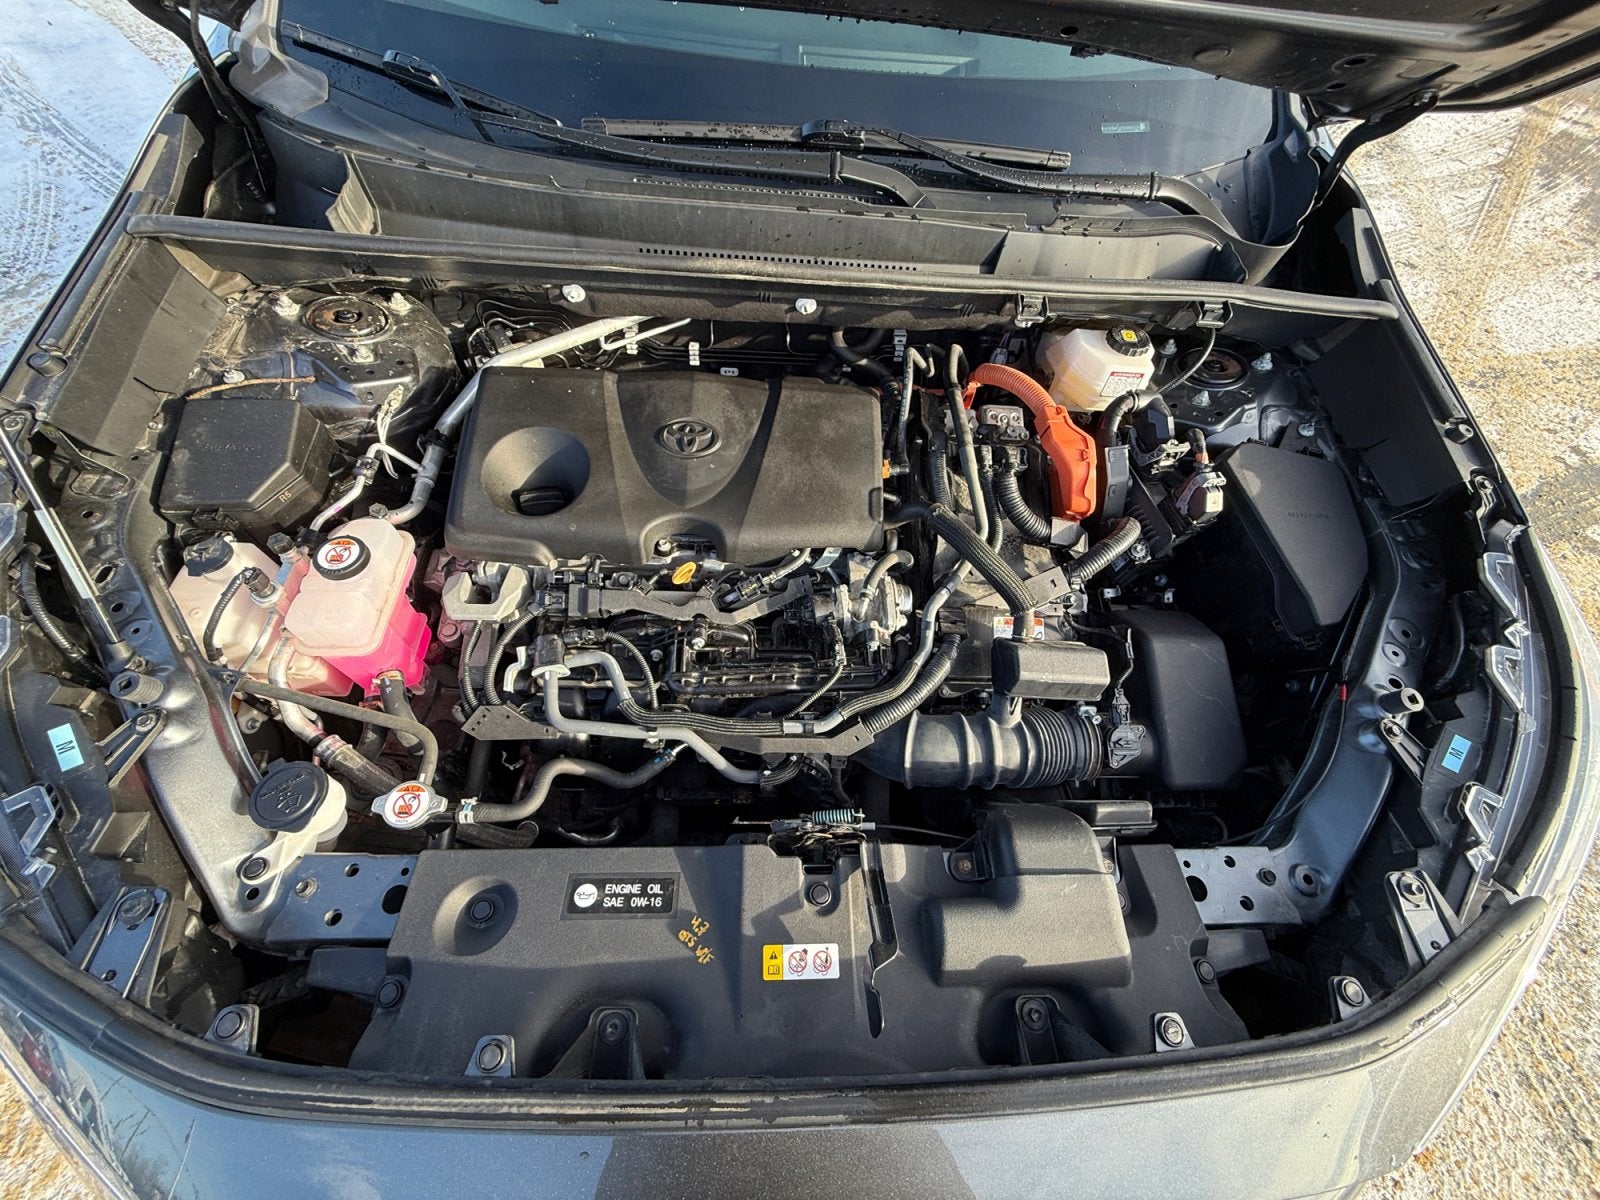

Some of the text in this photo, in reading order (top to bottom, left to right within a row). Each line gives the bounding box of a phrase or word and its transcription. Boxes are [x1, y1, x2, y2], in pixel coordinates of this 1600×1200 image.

[56, 740, 75, 755] M
[1449, 747, 1464, 760] M
[605, 884, 663, 894] ENGINE OIL
[603, 897, 662, 907] SAE 0W-16
